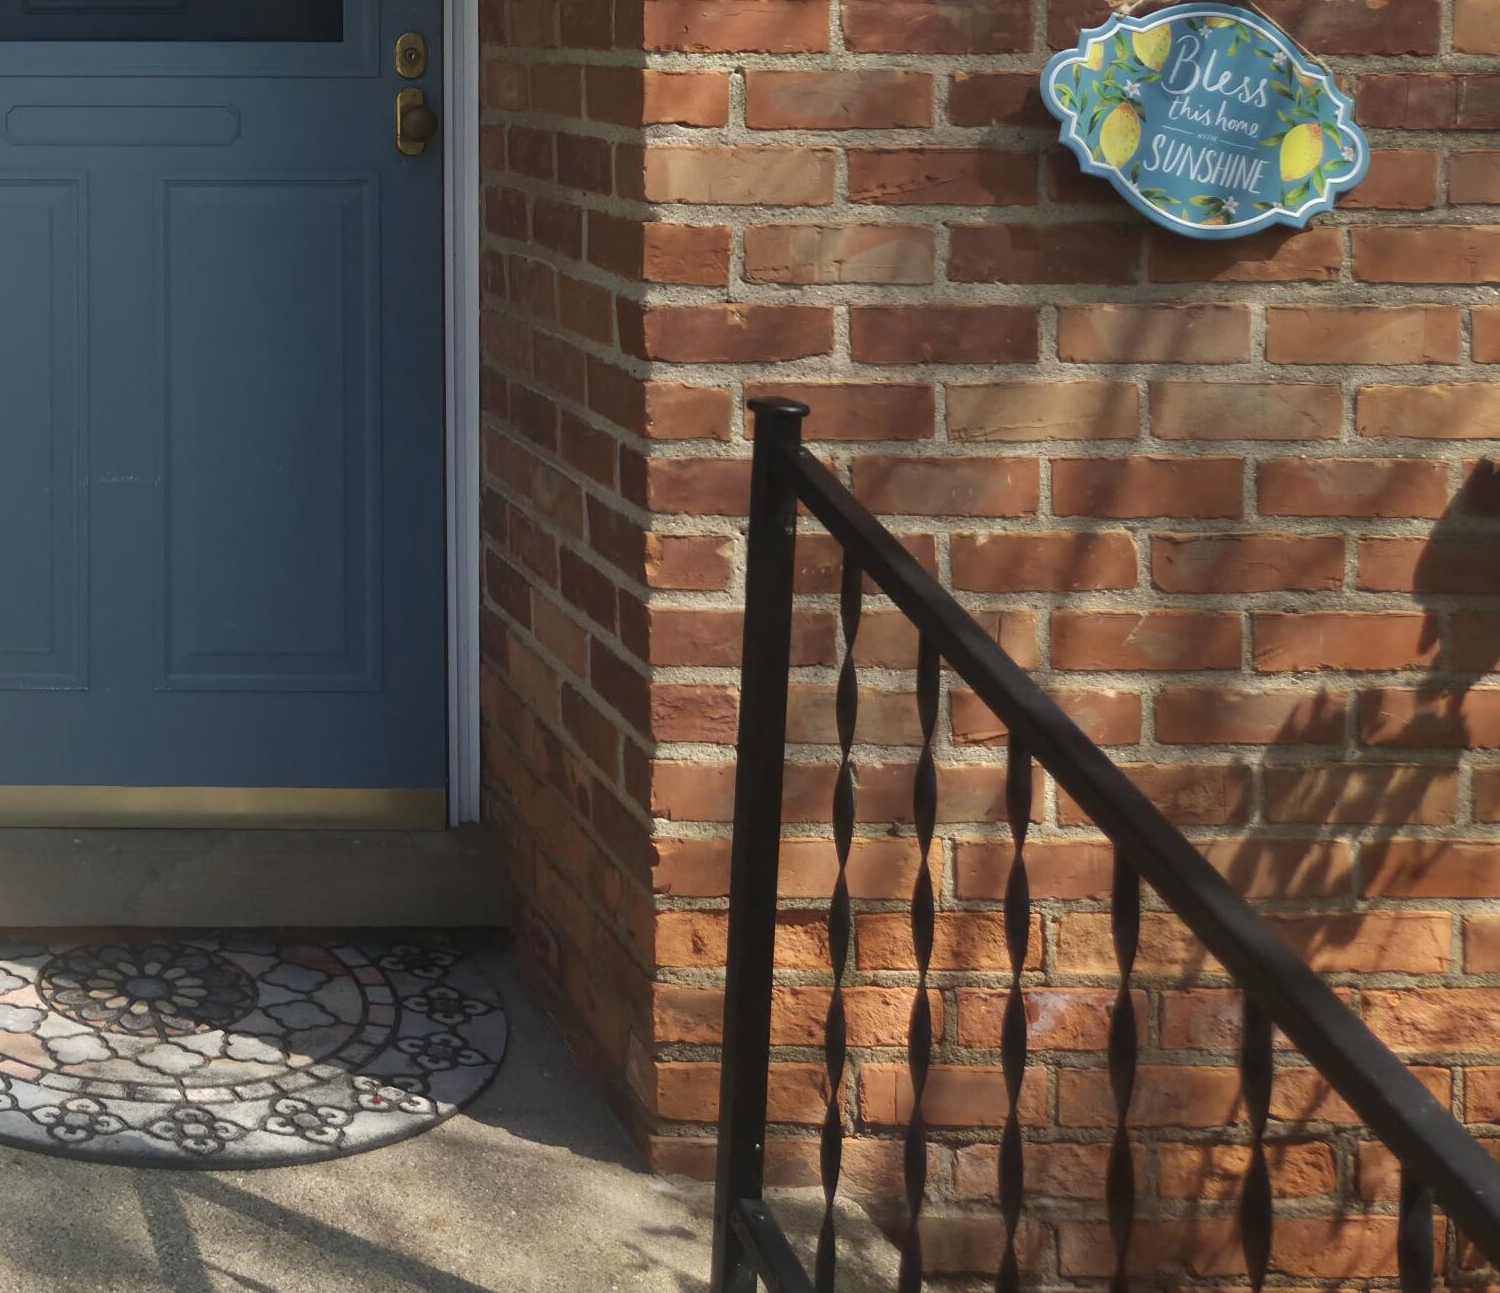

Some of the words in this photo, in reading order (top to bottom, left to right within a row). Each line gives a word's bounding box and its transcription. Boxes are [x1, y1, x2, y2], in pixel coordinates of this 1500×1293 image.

[1161, 34, 1268, 108] Bless
[1168, 96, 1211, 126] this
[1214, 100, 1259, 138] home
[1143, 133, 1271, 194] SUNSHINE
